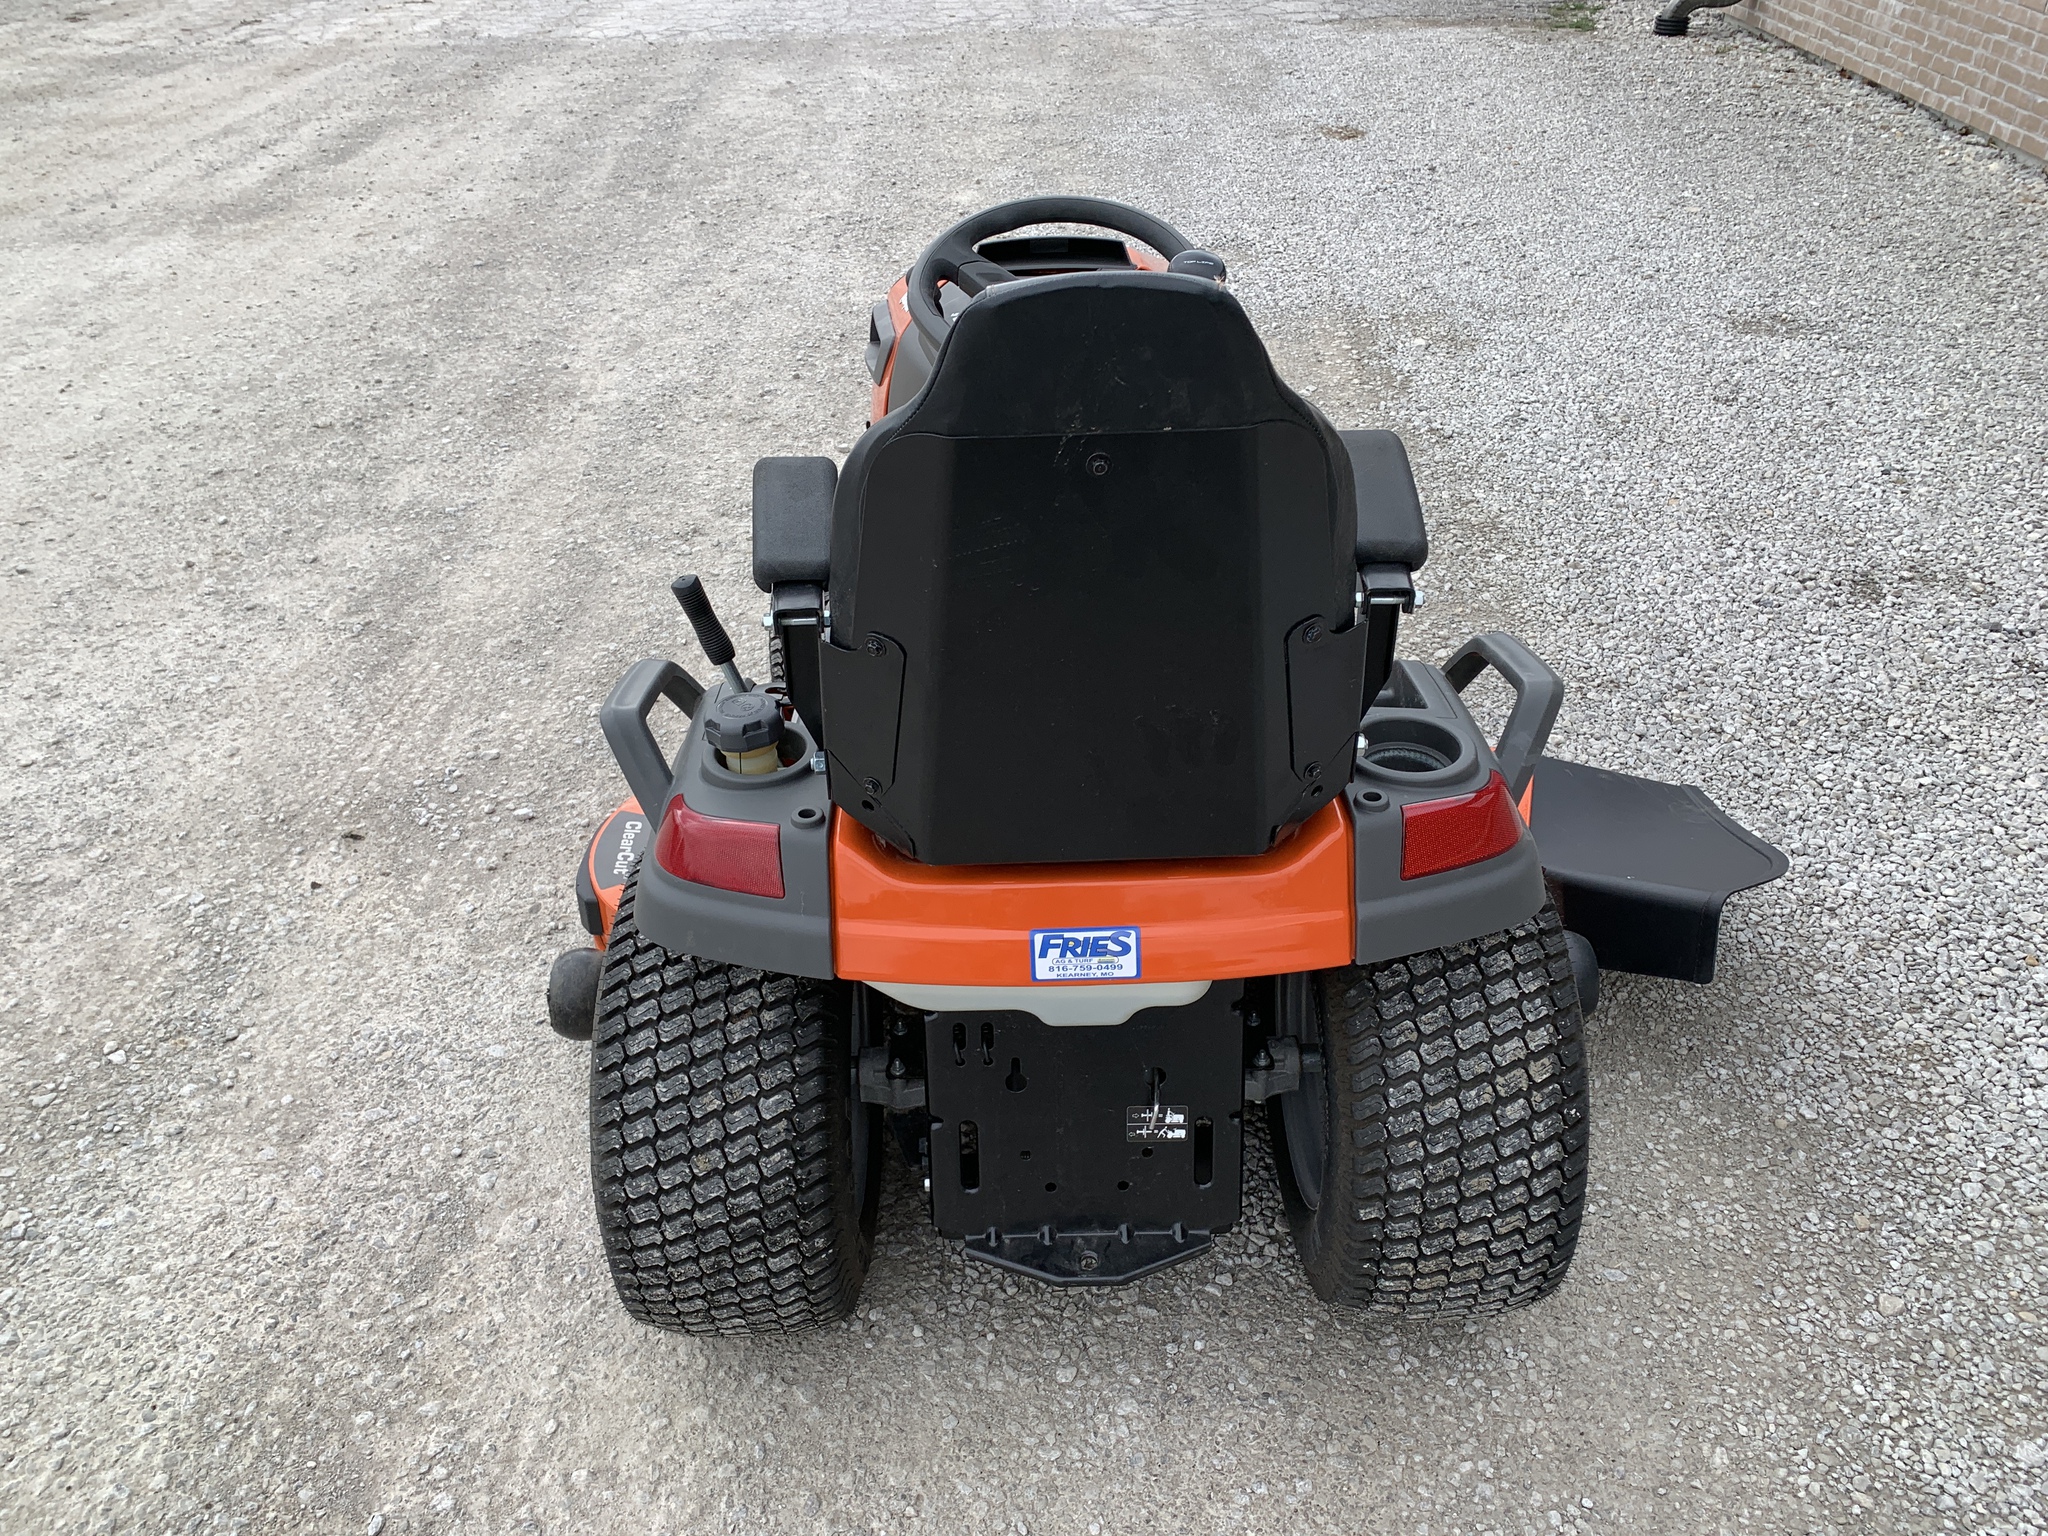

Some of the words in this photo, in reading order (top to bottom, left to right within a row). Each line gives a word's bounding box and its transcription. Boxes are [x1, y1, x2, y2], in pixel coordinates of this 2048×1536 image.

[613, 821, 642, 875] ClearCut
[1038, 931, 1132, 958] FRIES
[1048, 964, 1123, 972] 816-759-0499
